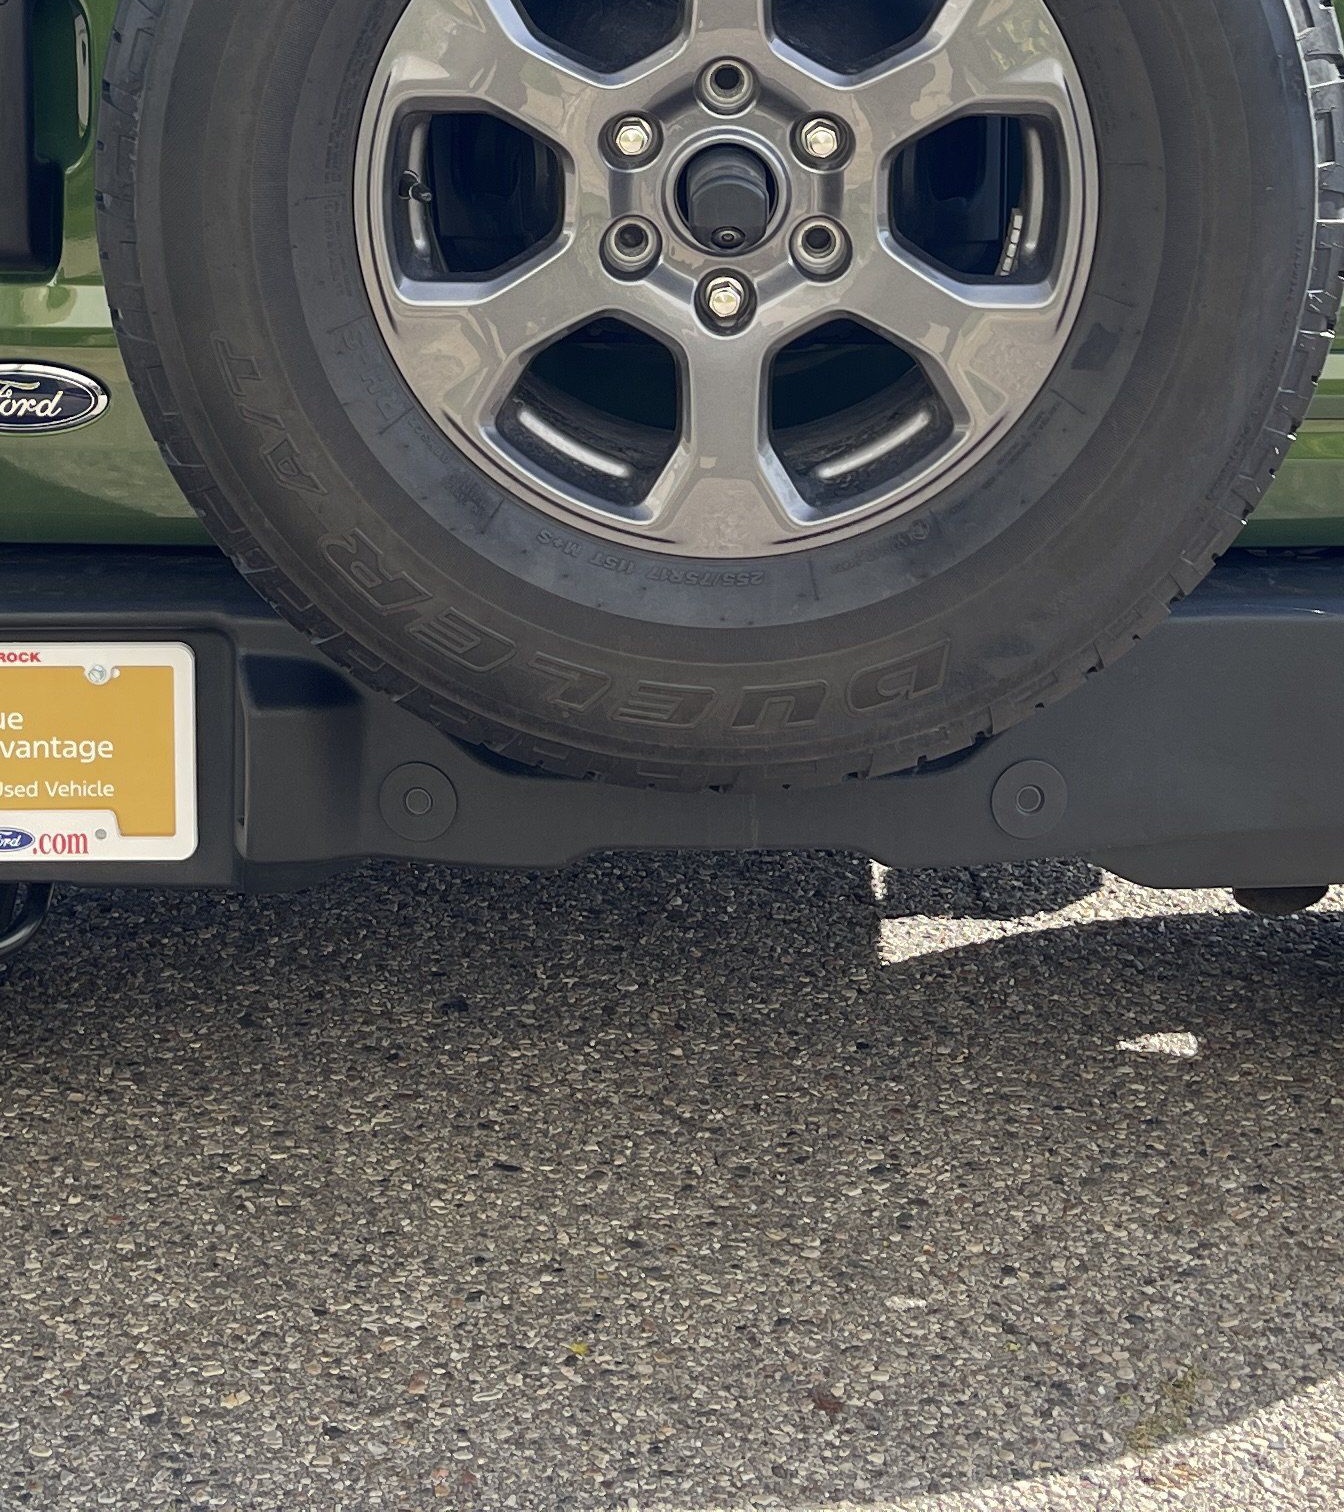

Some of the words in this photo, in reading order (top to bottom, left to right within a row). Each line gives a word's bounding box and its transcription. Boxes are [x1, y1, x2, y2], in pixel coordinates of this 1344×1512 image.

[210, 329, 328, 497] A/T
[536, 528, 582, 559] M+S
[646, 567, 764, 587] 255/75R17
[318, 528, 951, 730] DUELER
[45, 781, 114, 797] Vehicle
[32, 830, 89, 855] .com
